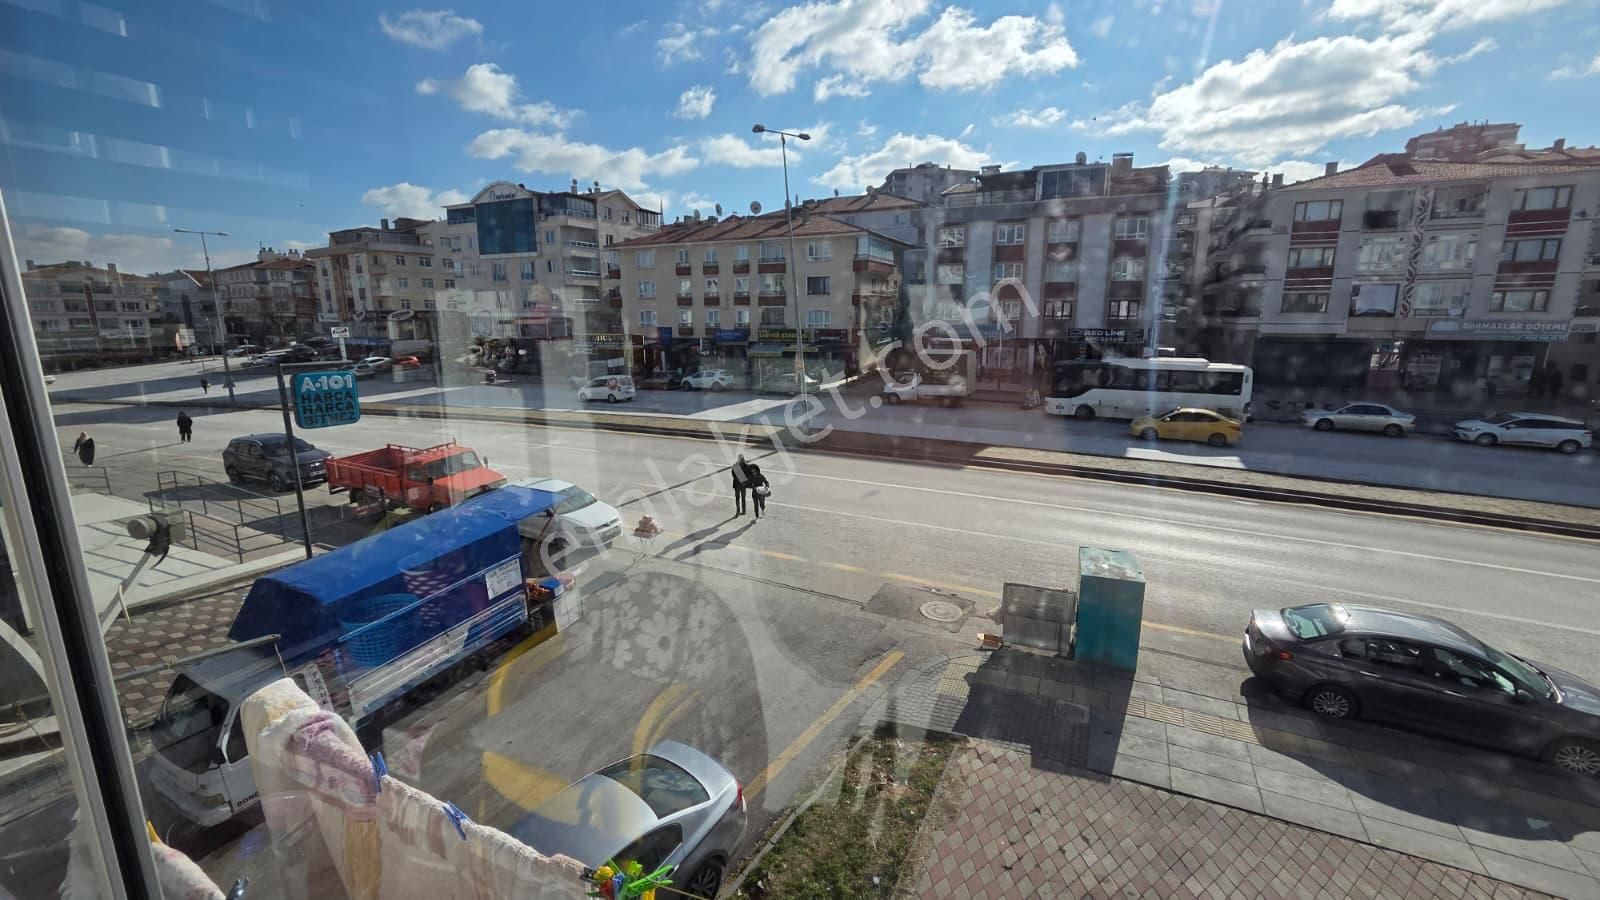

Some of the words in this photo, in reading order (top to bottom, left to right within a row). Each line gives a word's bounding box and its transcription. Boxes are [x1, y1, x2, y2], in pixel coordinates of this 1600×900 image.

[1462, 322, 1523, 330] DURMAZLAR
[301, 391, 353, 404] HARCA
[303, 401, 355, 415] HARCA
